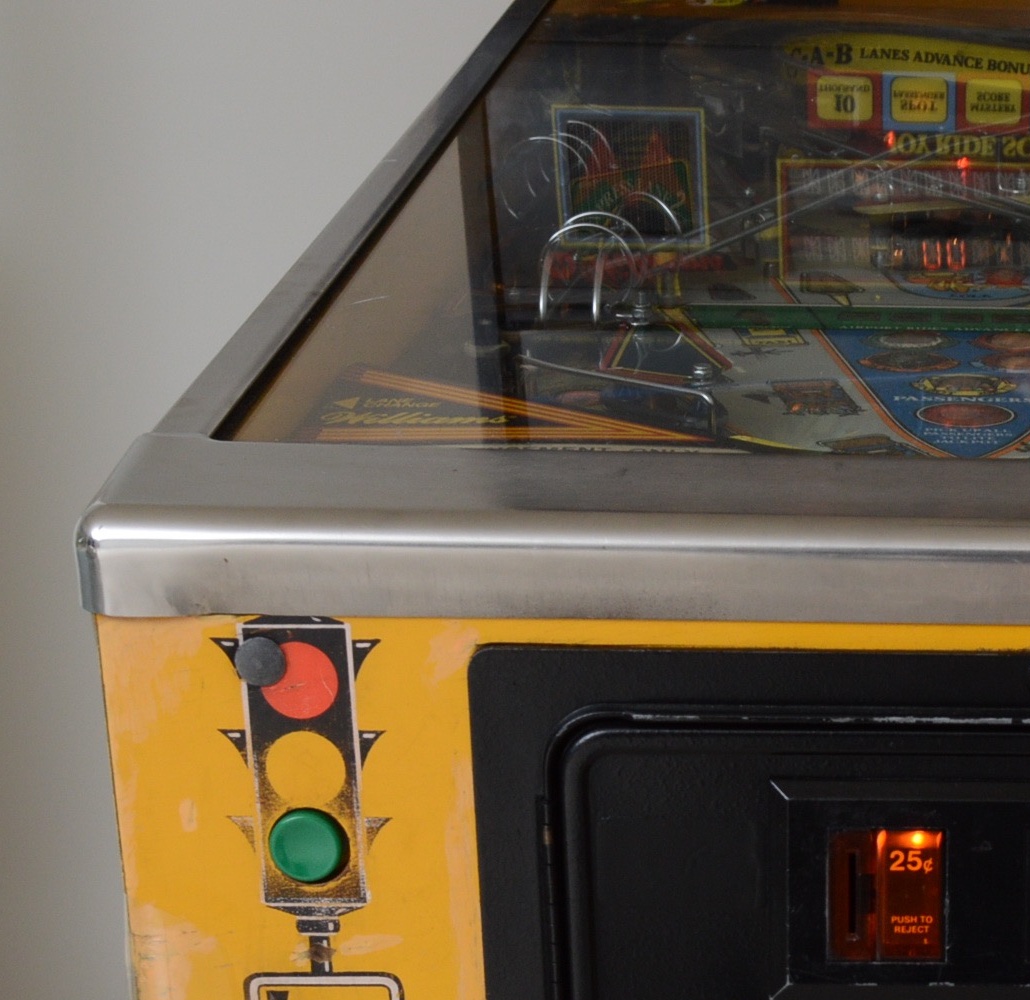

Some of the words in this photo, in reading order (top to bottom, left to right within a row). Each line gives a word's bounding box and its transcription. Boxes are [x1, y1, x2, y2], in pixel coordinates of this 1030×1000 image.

[859, 47, 909, 61] LANES
[913, 52, 983, 69] ADVANCE
[889, 850, 933, 874] 25¢
[891, 915, 918, 924] PUSH
[920, 915, 934, 924] TO
[894, 925, 930, 934] REJECT
